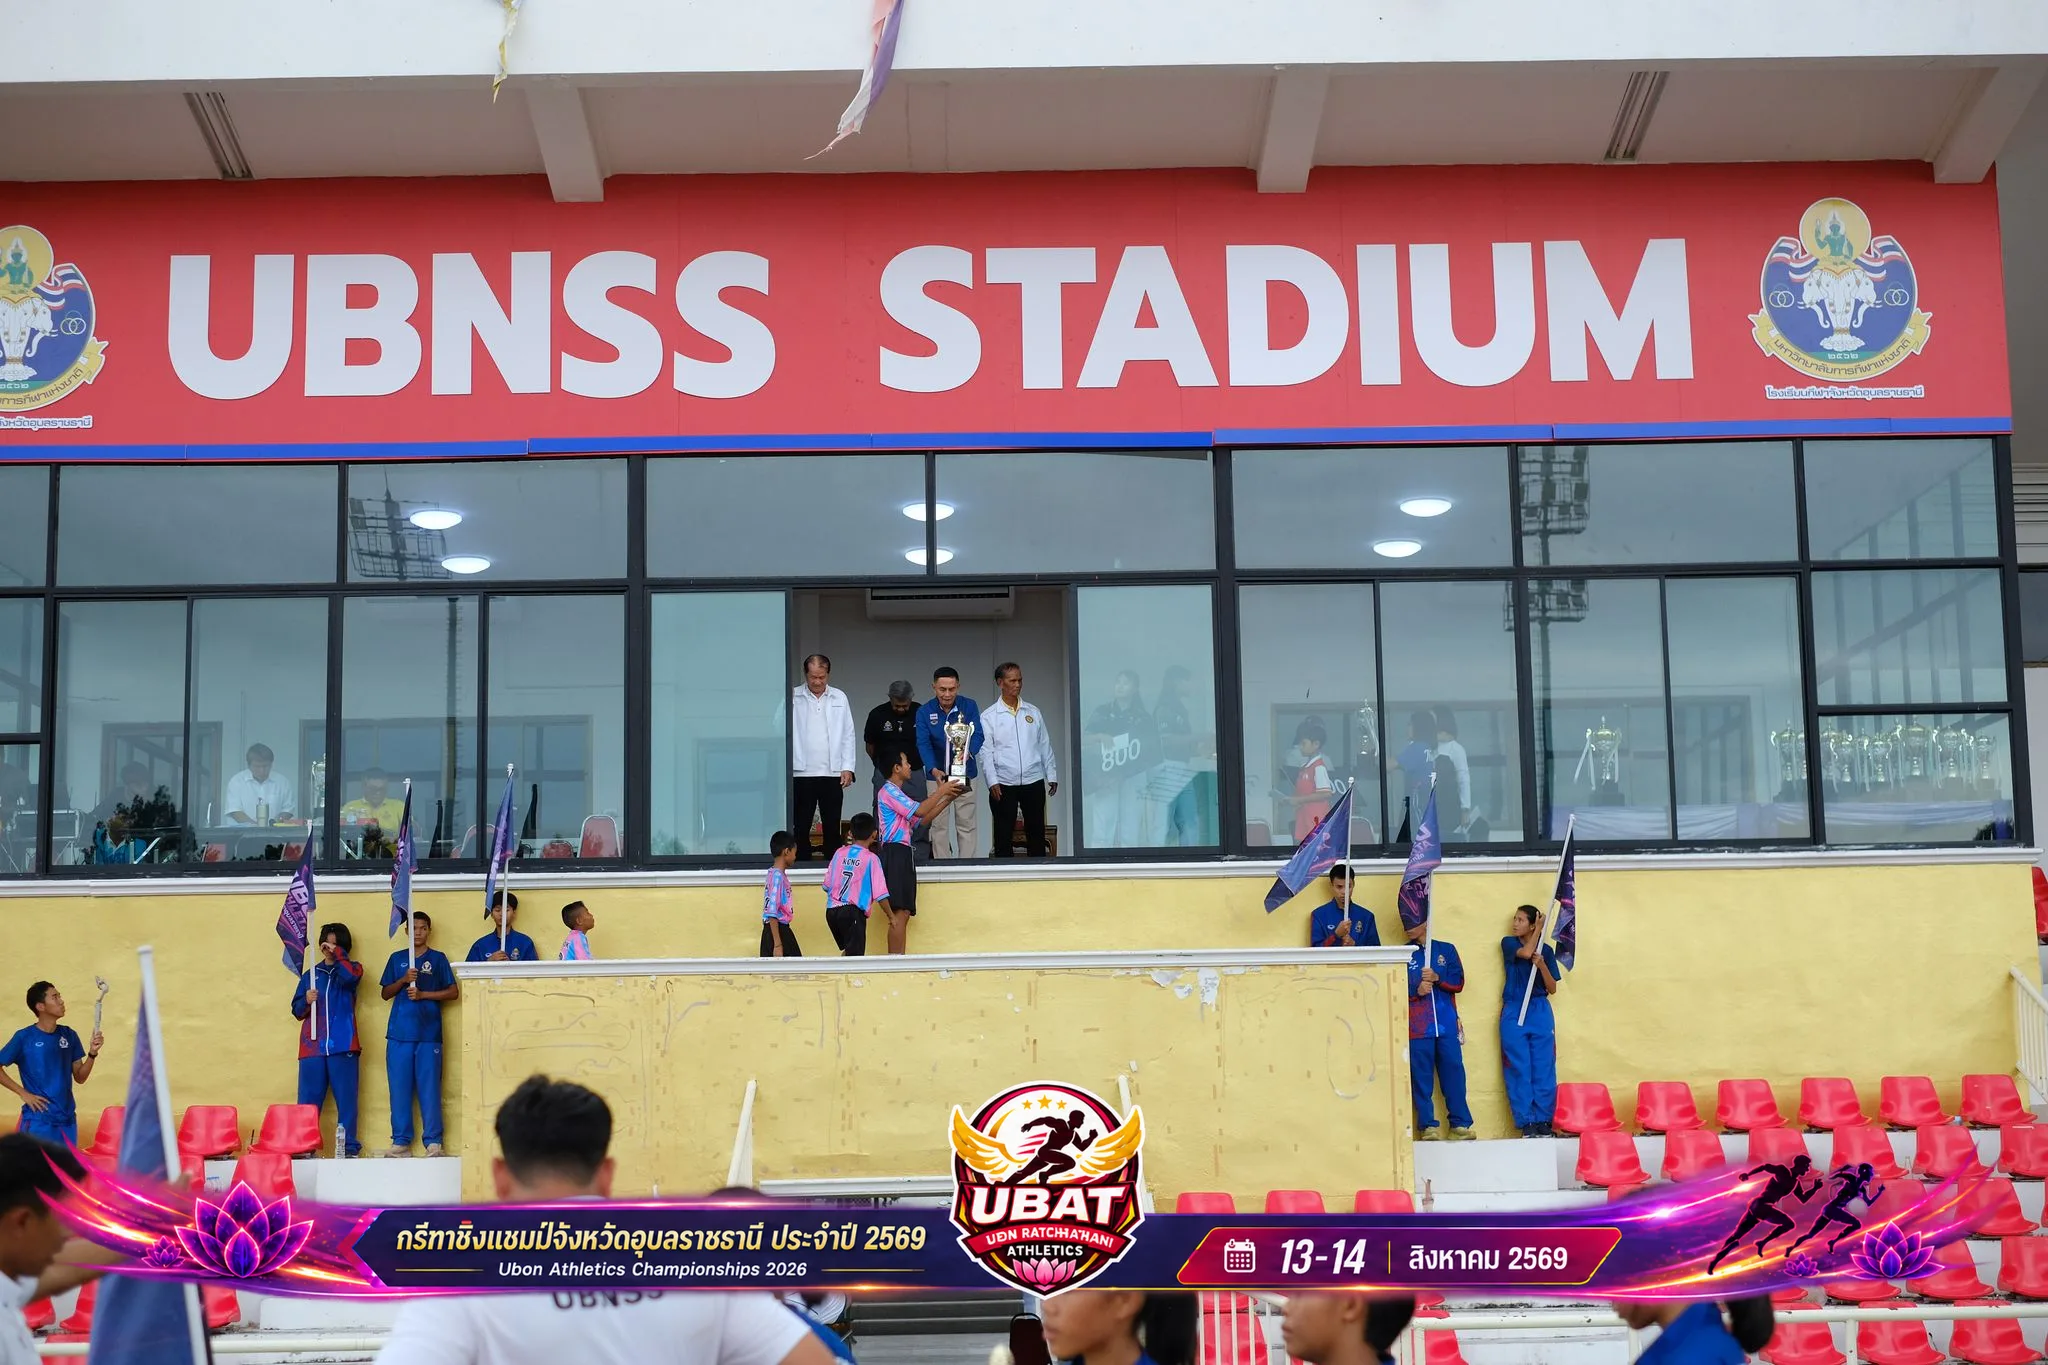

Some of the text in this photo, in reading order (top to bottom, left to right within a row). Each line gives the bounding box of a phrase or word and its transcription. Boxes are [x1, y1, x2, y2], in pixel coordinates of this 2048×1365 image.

[168, 237, 1695, 400] UBNSS STADIUM
[1773, 338, 1911, 375] มหาวิทยาลัยการกีฬาแห่งชาติ
[0, 367, 84, 405] การกีฬาแห่งชาติ
[1767, 386, 1923, 399] โรงเรียนกีฬาจังหวัดอุบลราชธานี
[0, 416, 91, 429] ังหวัดอุบลราชธานี
[838, 870, 853, 901] 7
